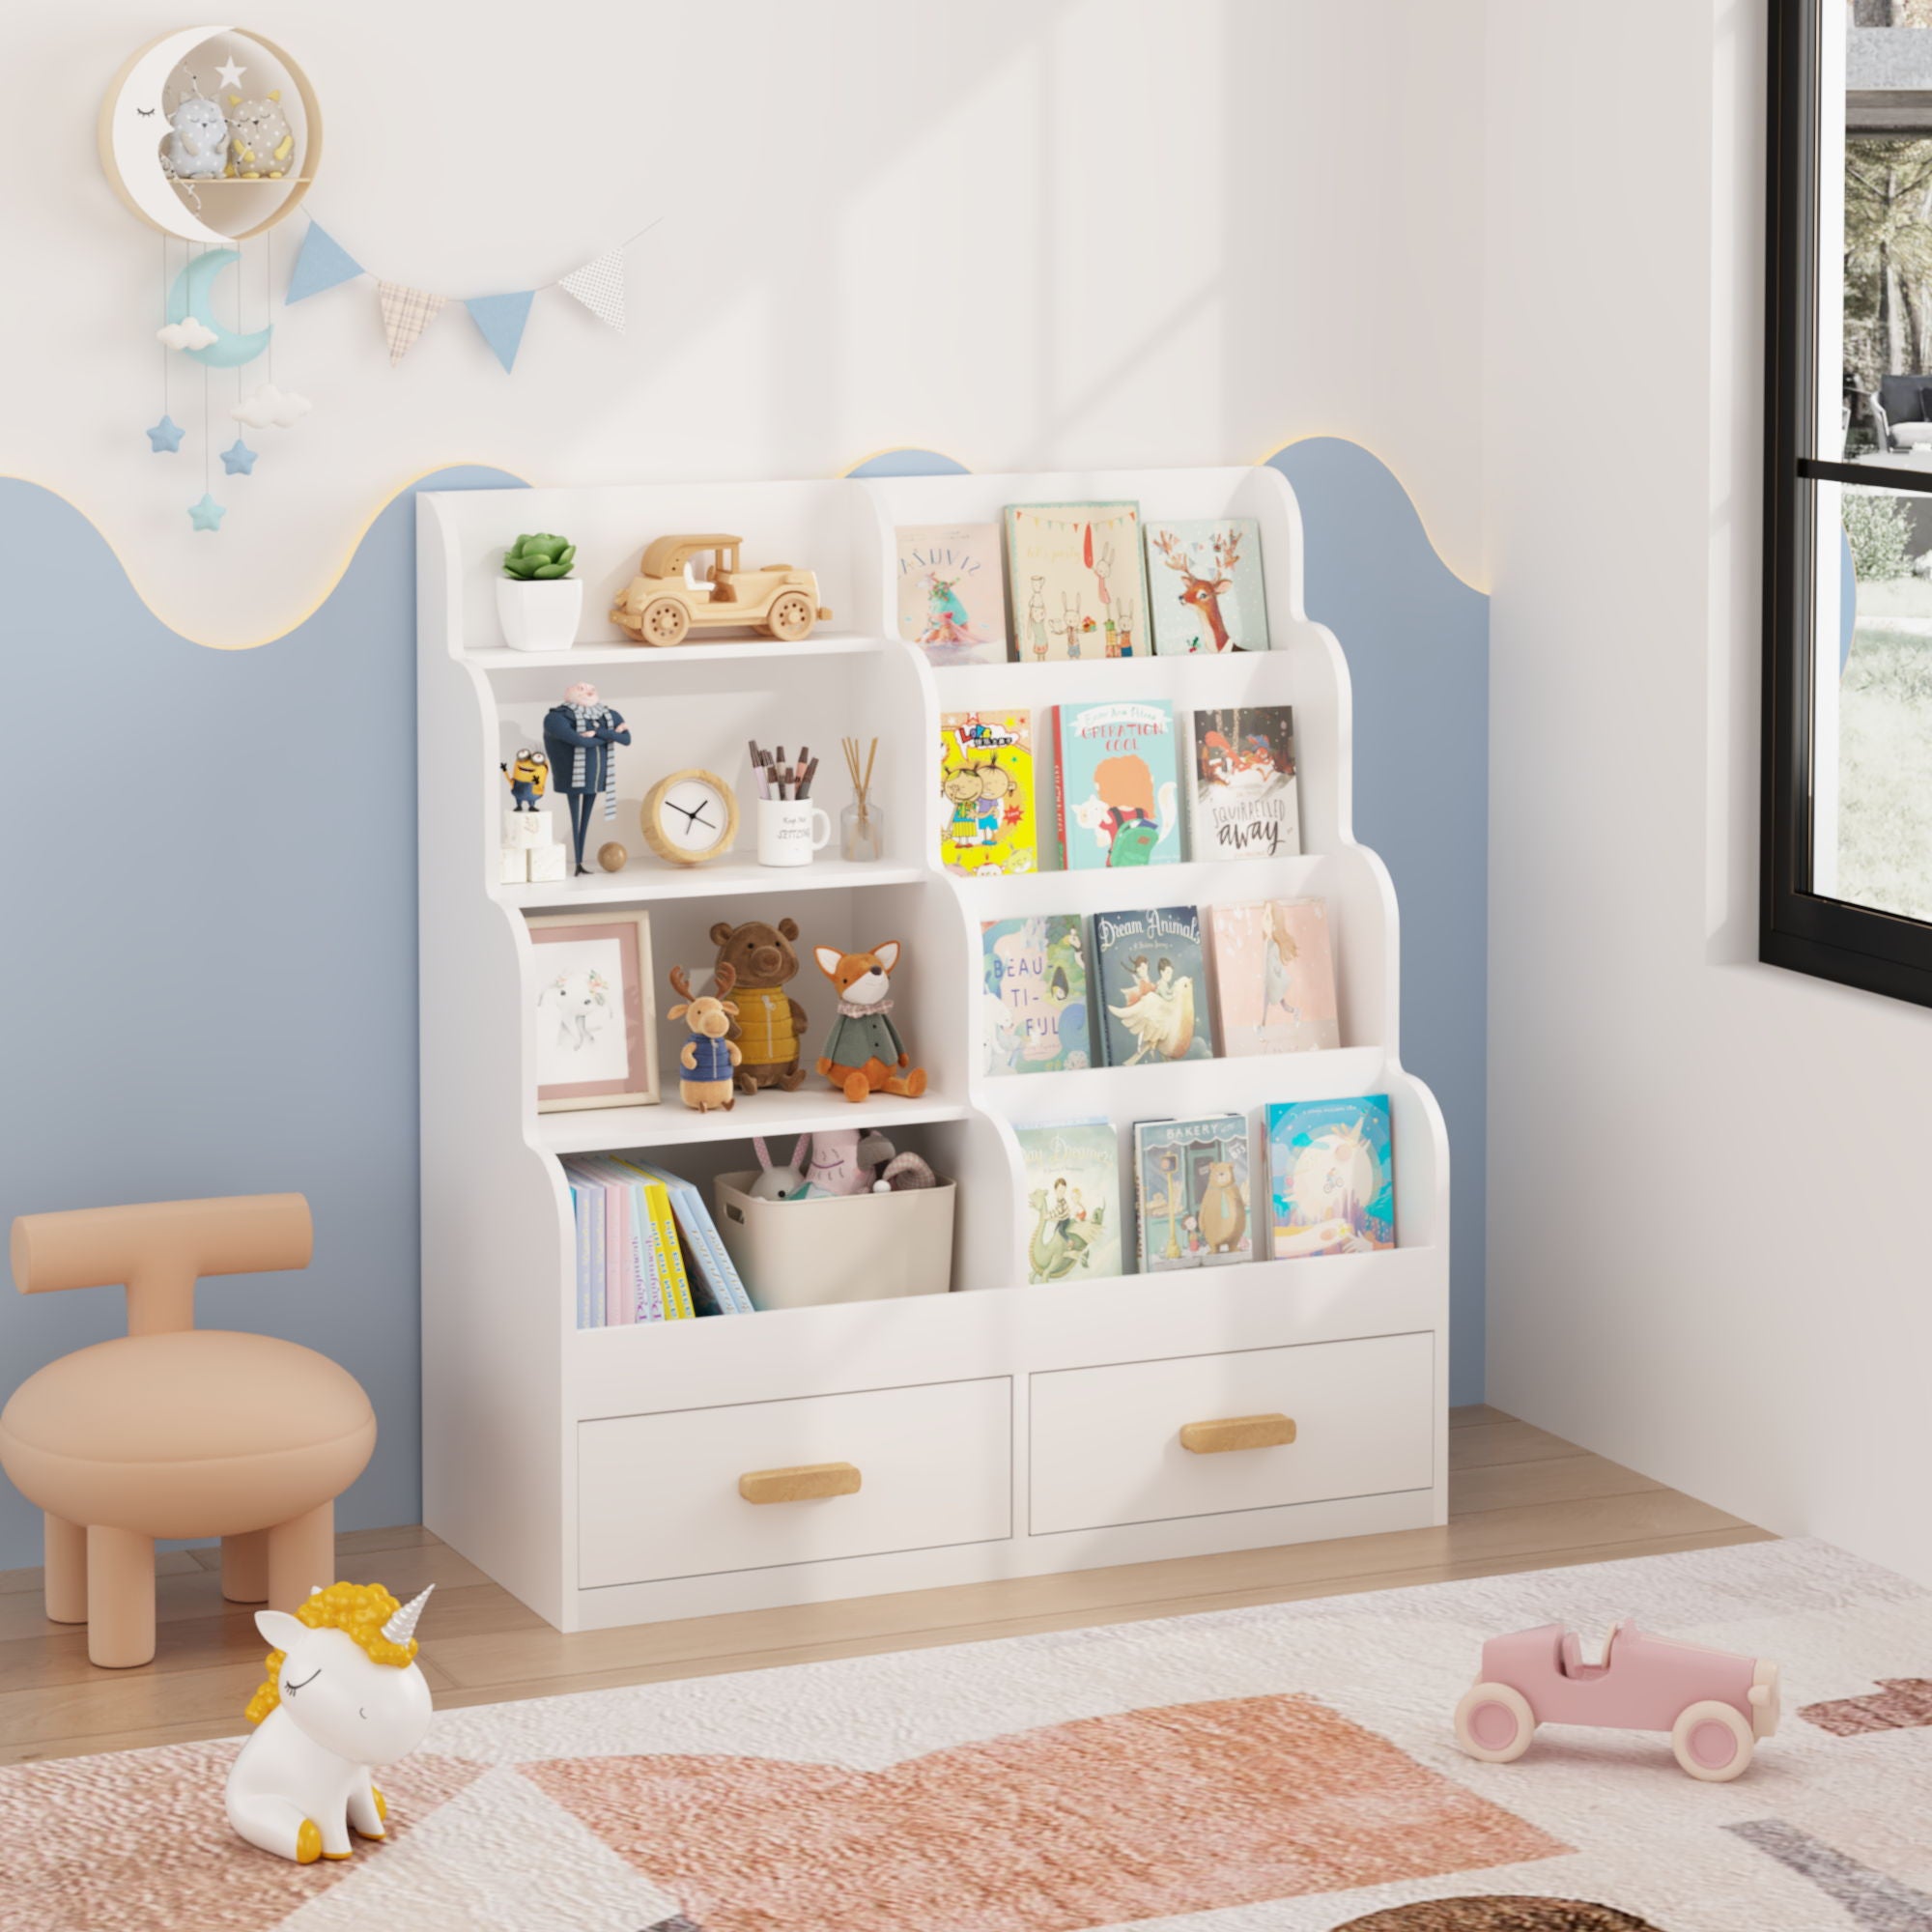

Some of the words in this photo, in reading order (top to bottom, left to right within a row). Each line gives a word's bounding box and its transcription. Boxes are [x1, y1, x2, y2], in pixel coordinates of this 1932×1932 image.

[1212, 799, 1286, 829] SQUIRRELLED
[1217, 820, 1286, 856] away
[1098, 917, 1144, 952] Dream
[1146, 909, 1201, 945] Animals
[993, 956, 1054, 979] BEAU-
[1010, 988, 1039, 1008] TI-
[1025, 1016, 1060, 1037] FUL
[1166, 1122, 1218, 1140] BAKERY
